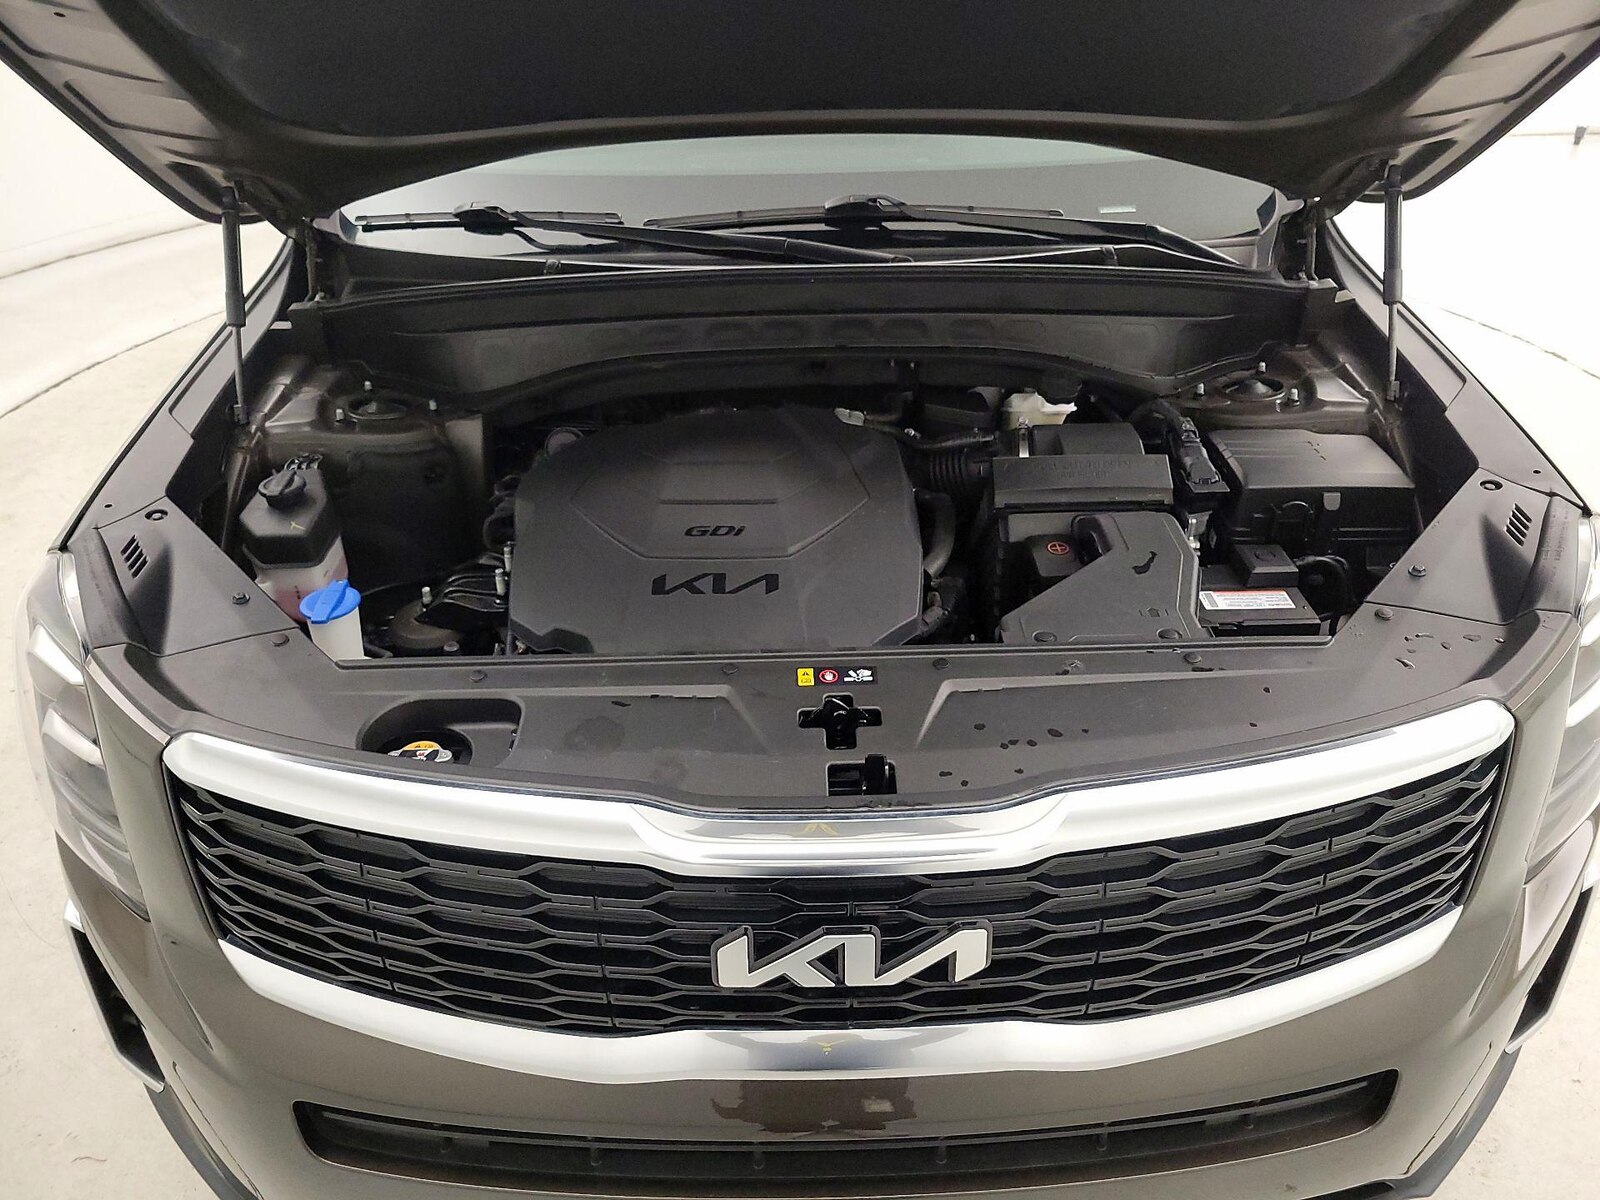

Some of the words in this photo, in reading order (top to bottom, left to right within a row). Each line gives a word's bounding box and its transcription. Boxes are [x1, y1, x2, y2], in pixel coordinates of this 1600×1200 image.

[684, 525, 746, 537] GDi
[651, 572, 780, 596] KIA
[712, 922, 991, 988] KIA
